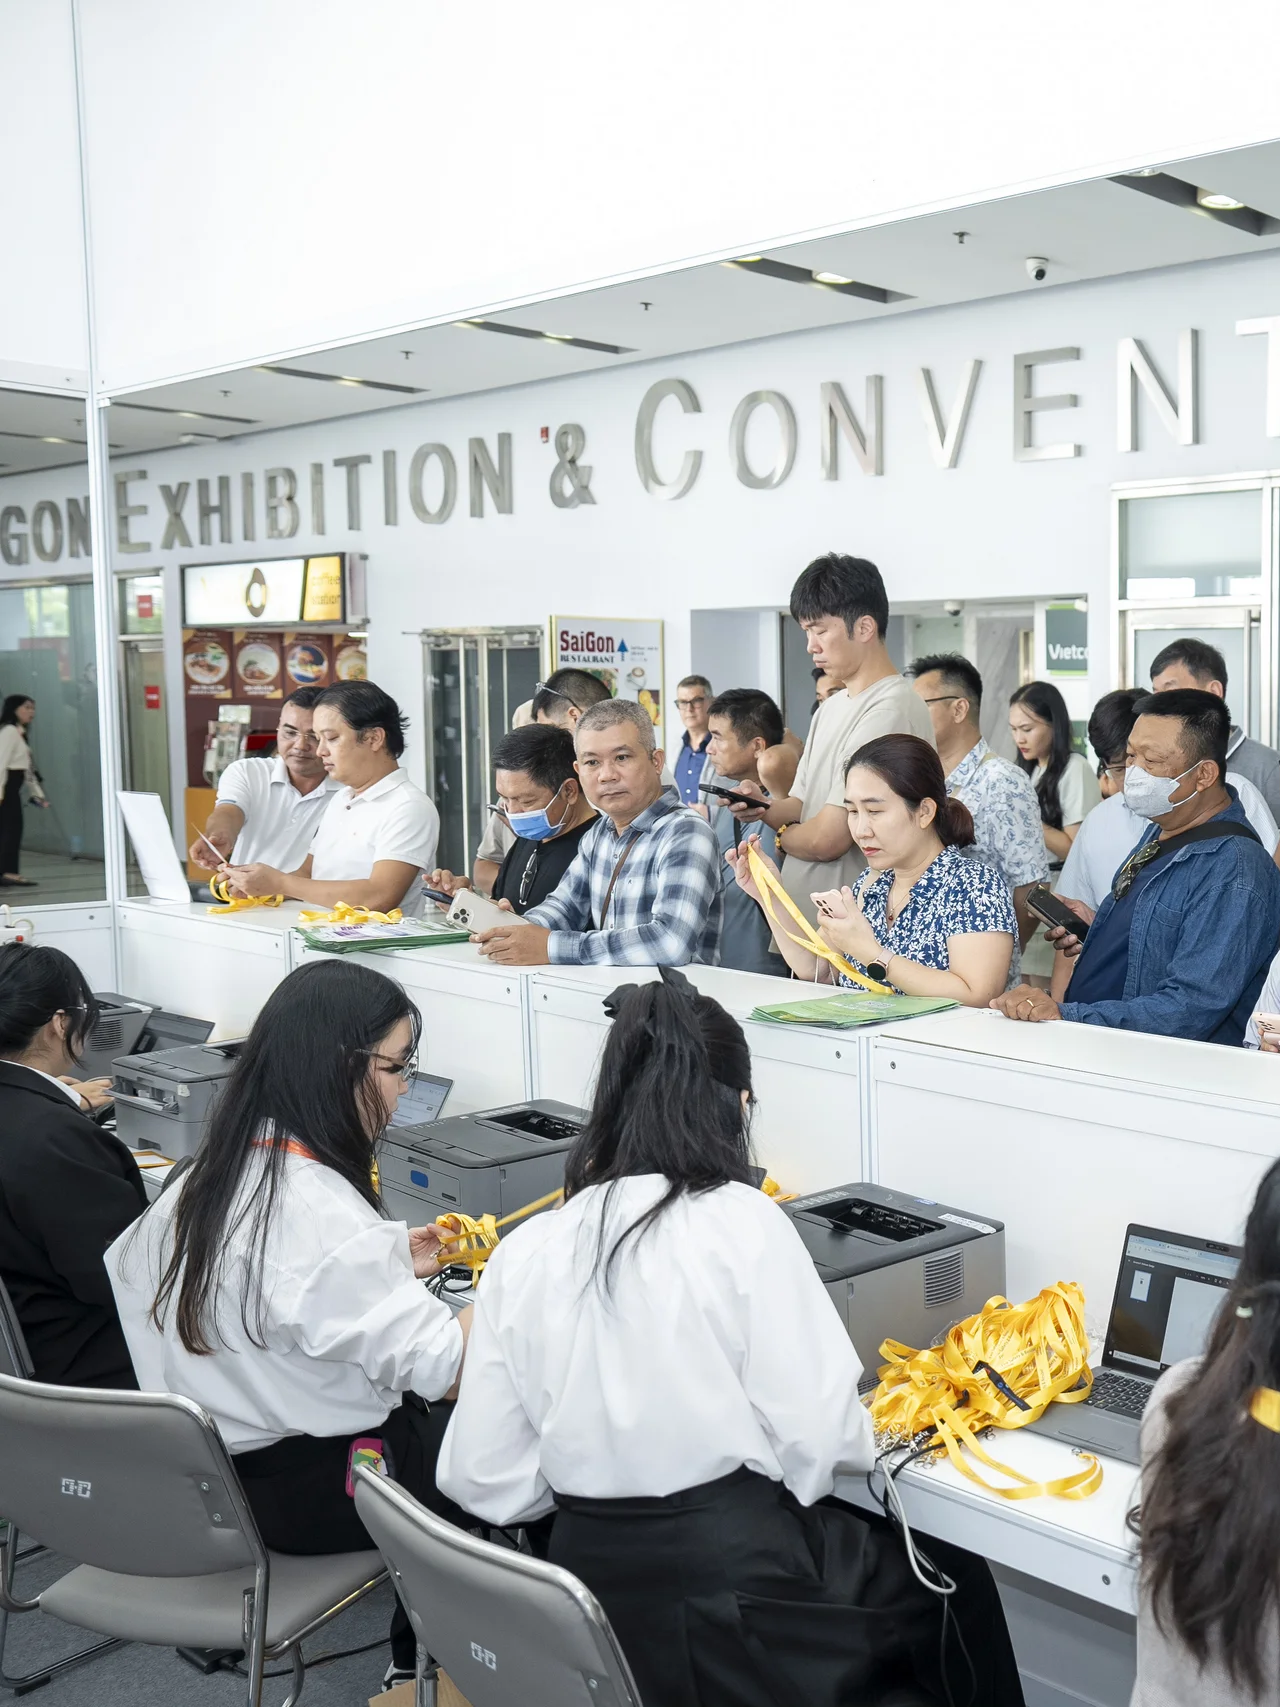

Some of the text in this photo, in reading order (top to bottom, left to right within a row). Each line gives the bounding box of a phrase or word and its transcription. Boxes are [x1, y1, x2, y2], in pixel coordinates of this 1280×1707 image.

[0, 494, 92, 566] GON
[114, 432, 513, 553] EXHIBITION
[549, 423, 597, 508] &
[560, 629, 615, 653] SaiGon
[560, 654, 615, 664] RESTAURANT
